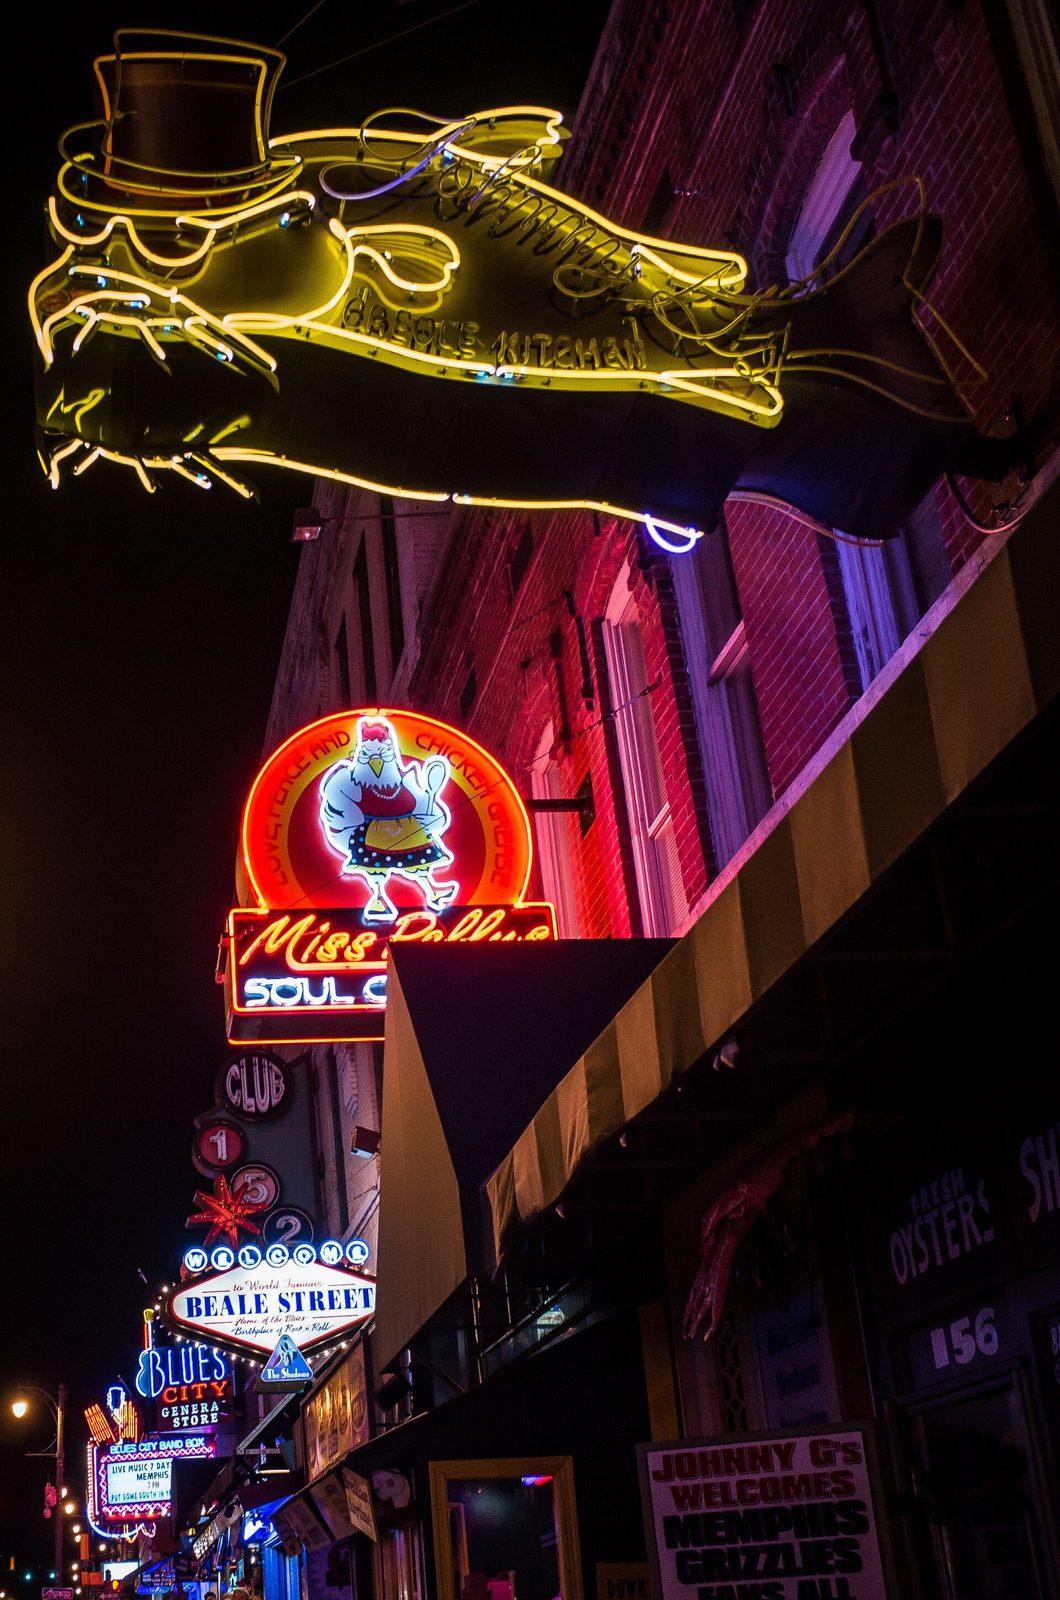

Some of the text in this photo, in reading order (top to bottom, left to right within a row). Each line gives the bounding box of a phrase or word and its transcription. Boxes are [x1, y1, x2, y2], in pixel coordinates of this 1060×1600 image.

[267, 755, 312, 819] PEACE
[308, 730, 351, 762] AND
[414, 732, 492, 800] CHICKEN
[238, 914, 379, 965] Miss
[243, 976, 356, 1006] SOUL
[225, 1056, 285, 1113] CLUB
[209, 1128, 227, 1160] 1
[243, 1172, 268, 1203] 5
[909, 1167, 966, 1215] FRESH
[275, 1214, 302, 1242] 2
[186, 1241, 369, 1270] WELCOME
[244, 1279, 280, 1291] World
[185, 1287, 374, 1318] BEALE STREET
[311, 1321, 335, 1332] Roll
[929, 1306, 1000, 1370] 156
[149, 1343, 226, 1398] BLUES
[266, 1366, 310, 1379] The Shadows
[161, 1380, 228, 1404] CITY
[172, 1412, 219, 1428] STORE
[159, 1439, 183, 1451] BAND
[185, 1437, 206, 1448] BOX
[112, 1464, 126, 1474] LIVE
[128, 1463, 148, 1473] MUSIC
[156, 1460, 172, 1470] DAY
[136, 1470, 169, 1481] MEMPHIS
[652, 1441, 797, 1482] JOHNNY
[110, 1493, 121, 1502] PUT
[139, 1490, 157, 1499] SOUTH
[669, 1469, 856, 1512] WELCOMES
[662, 1499, 870, 1550] MEMPHIS
[675, 1537, 864, 1585] GRIZZLIES
